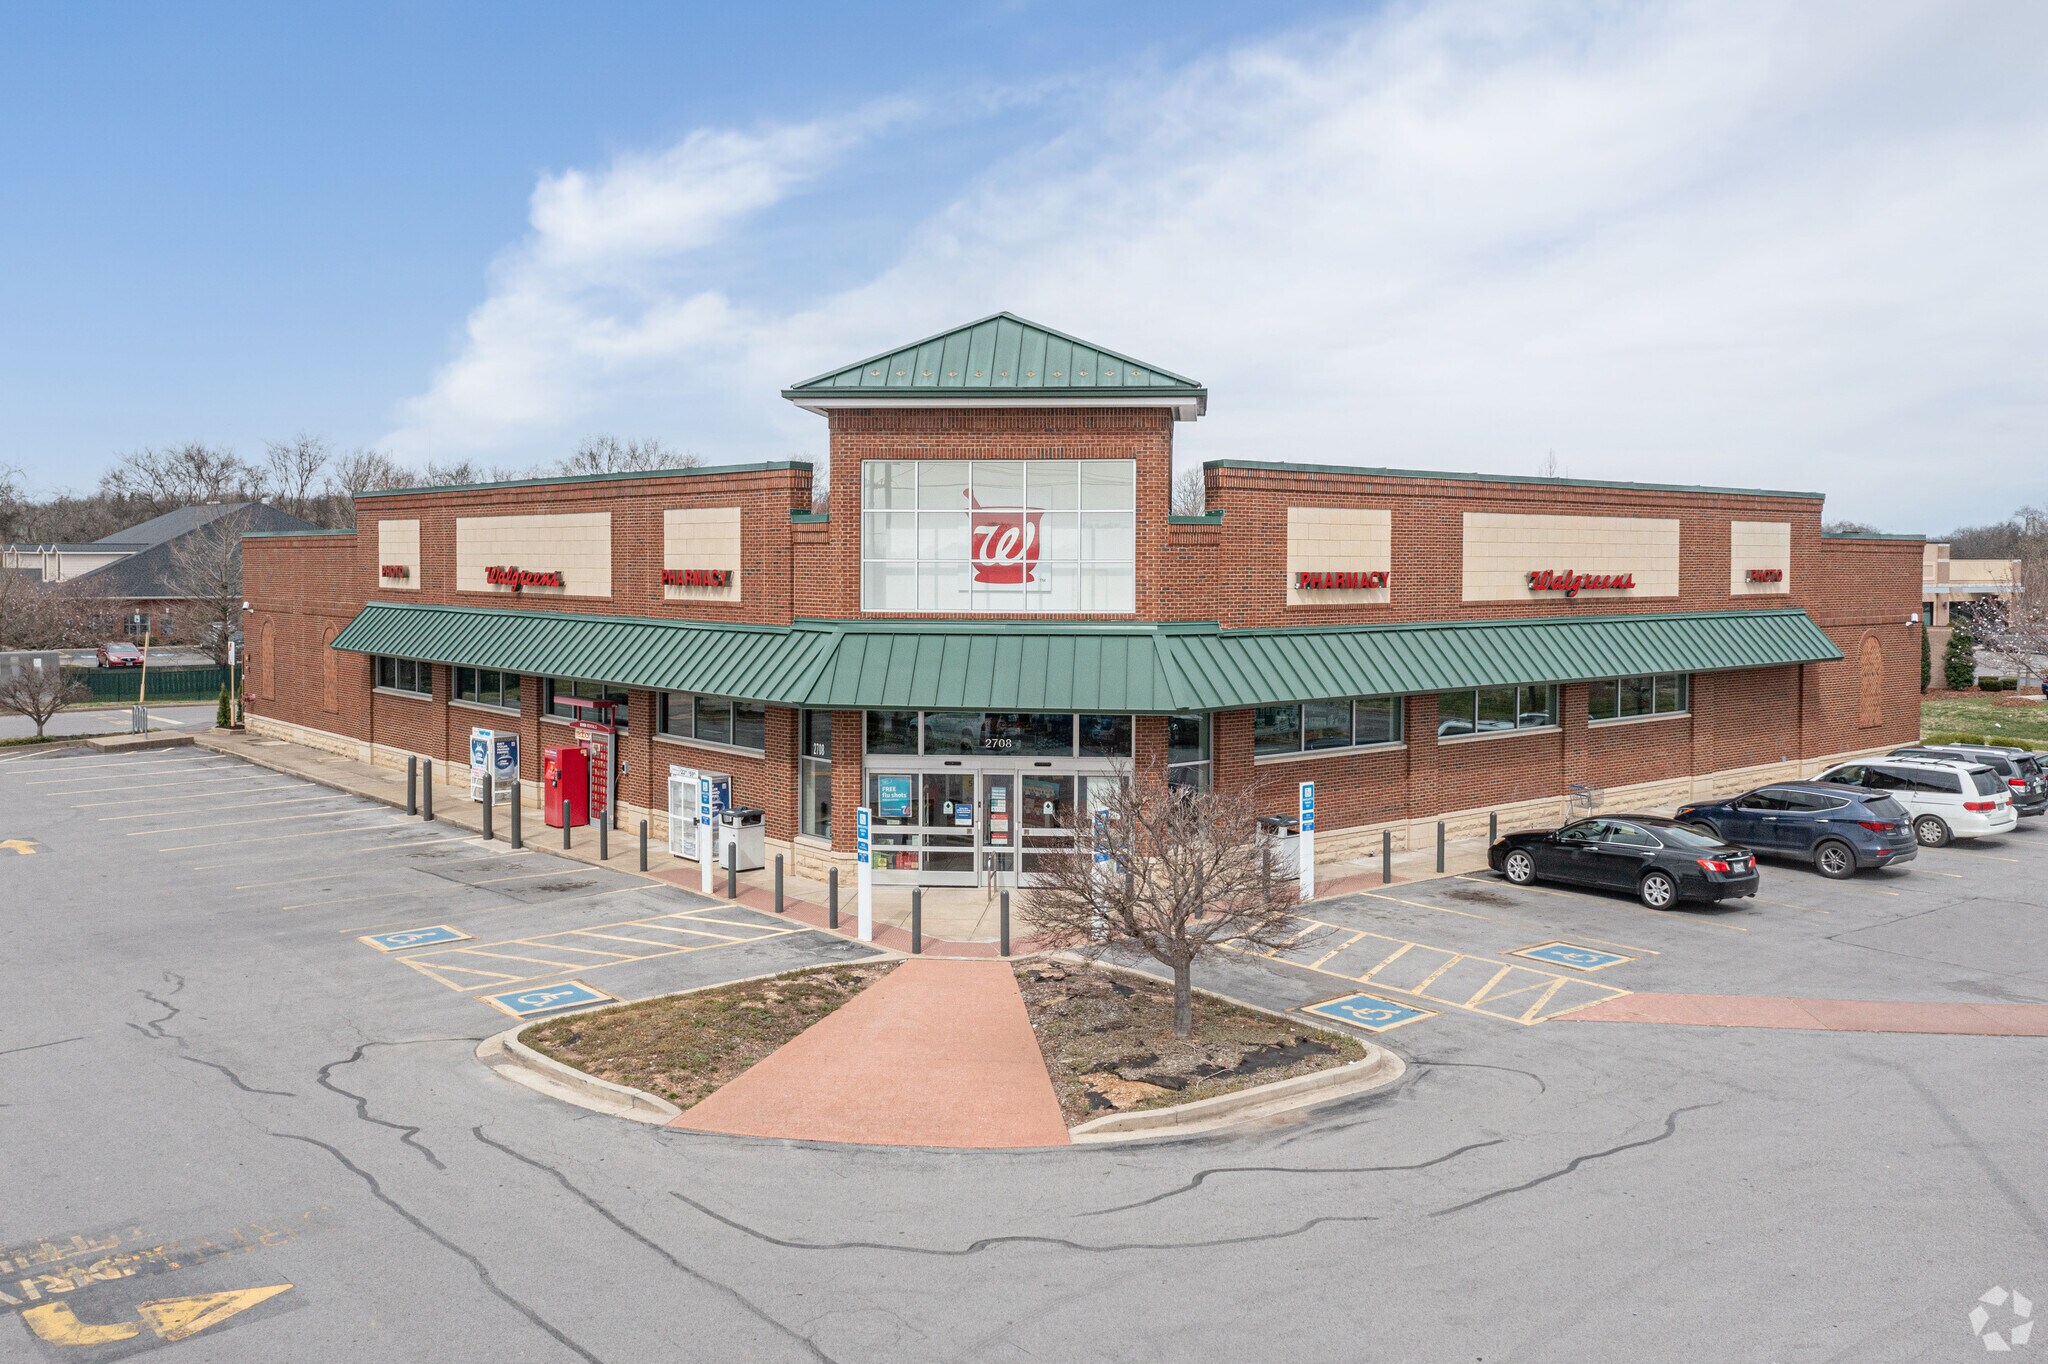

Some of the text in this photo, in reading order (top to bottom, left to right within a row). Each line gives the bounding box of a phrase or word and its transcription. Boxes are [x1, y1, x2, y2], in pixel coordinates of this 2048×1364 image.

[381, 565, 404, 578] PHOTO
[485, 565, 559, 592] Walgreens
[661, 569, 727, 588] PHARMACY
[1751, 569, 1783, 583] PHOTO
[1300, 571, 1390, 589] PHARMACY
[1530, 569, 1636, 597] Walgreens
[813, 742, 825, 756] 2708
[986, 738, 1012, 748] 2708
